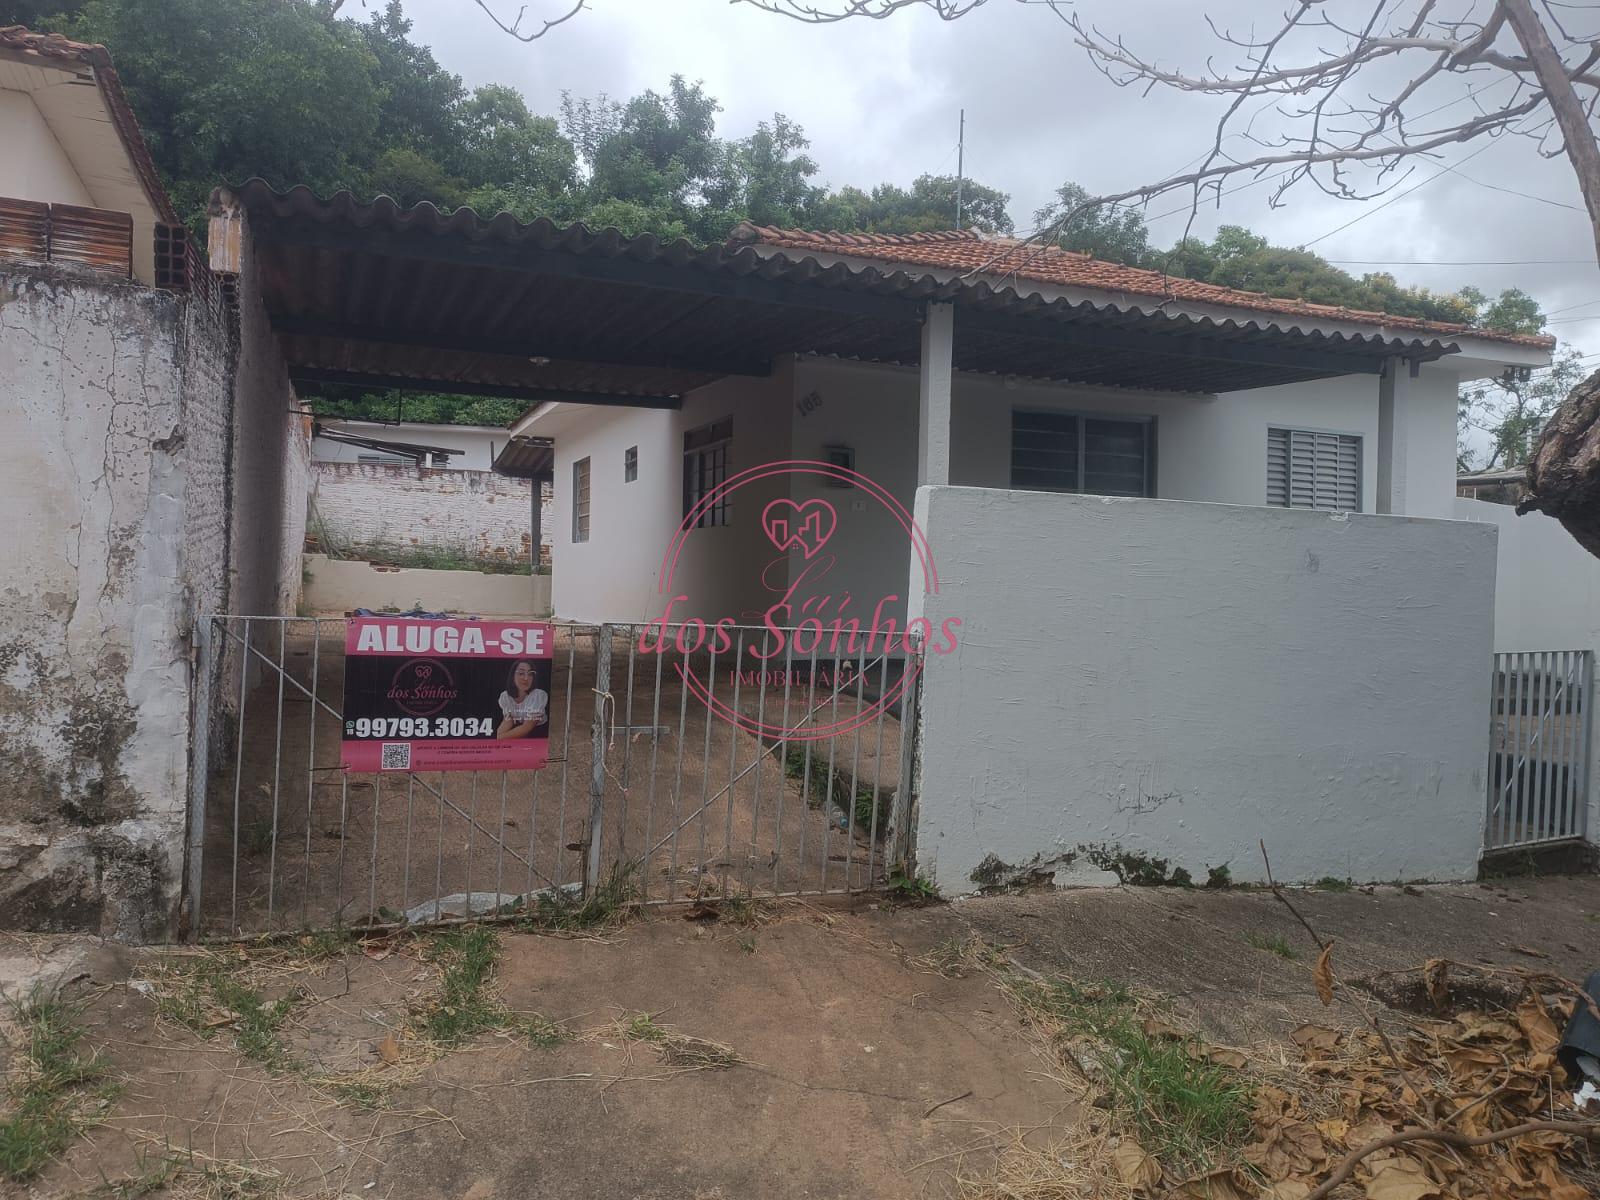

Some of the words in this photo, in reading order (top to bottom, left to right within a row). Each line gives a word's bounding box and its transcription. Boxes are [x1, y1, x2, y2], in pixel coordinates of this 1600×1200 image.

[357, 624, 544, 655] ALUGA-SE
[387, 684, 409, 699] dos
[410, 684, 458, 699] Sonhos
[355, 717, 494, 738] 99793.3034
